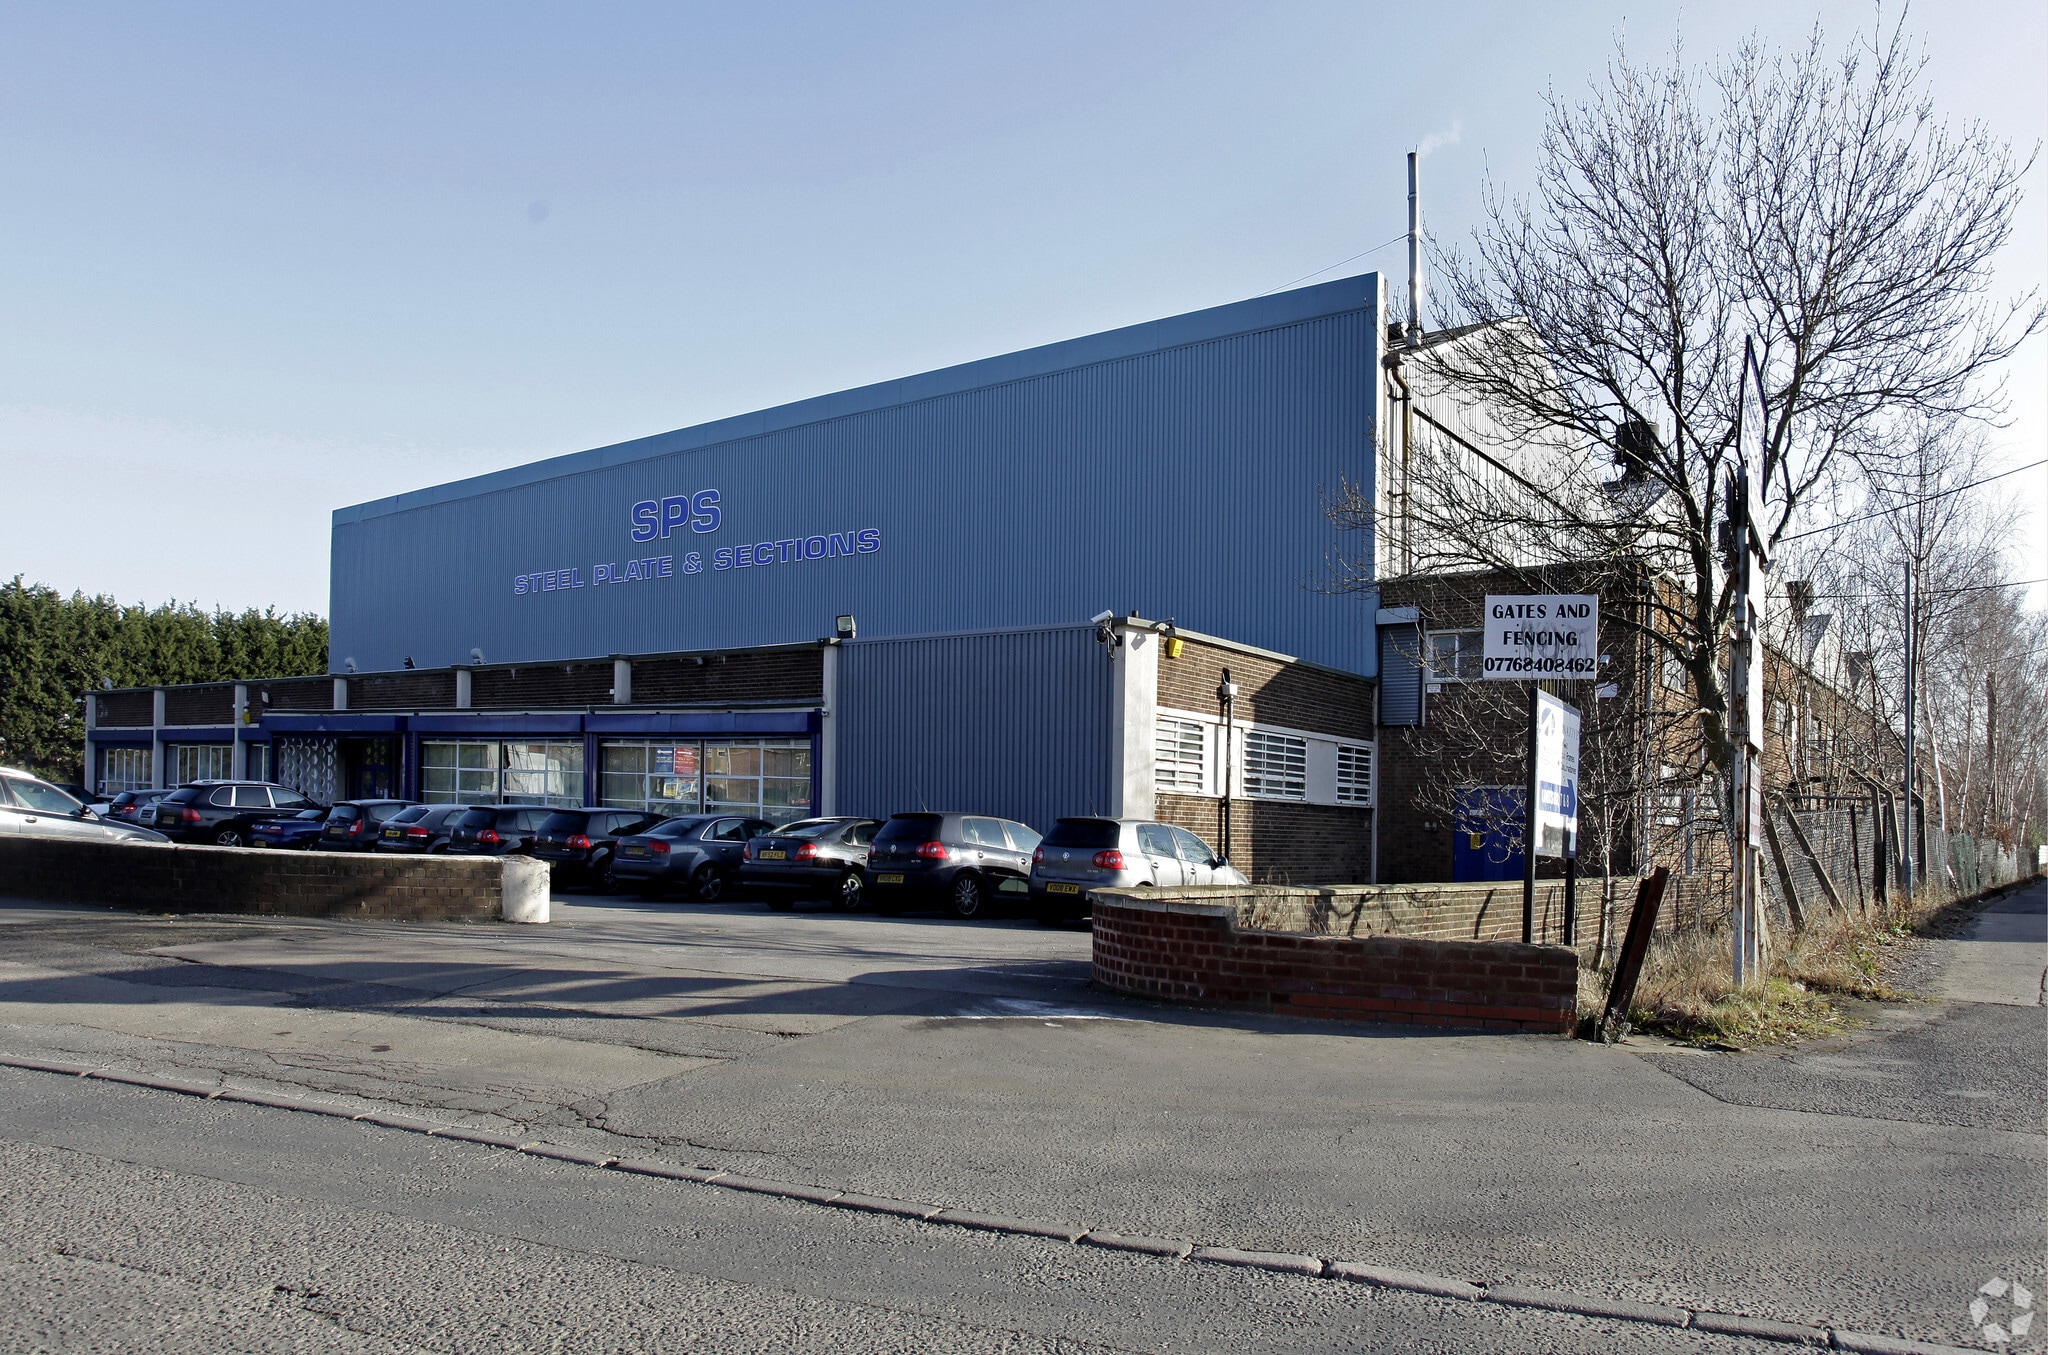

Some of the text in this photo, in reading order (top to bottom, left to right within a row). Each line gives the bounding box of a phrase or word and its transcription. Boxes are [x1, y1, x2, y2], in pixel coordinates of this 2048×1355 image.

[630, 488, 722, 543] SPS
[514, 528, 881, 595] STEEL PLATE & SECTIONS
[1492, 603, 1591, 619] GATES AND
[1503, 630, 1578, 646] FENCING
[1484, 657, 1595, 673] 07768408462
